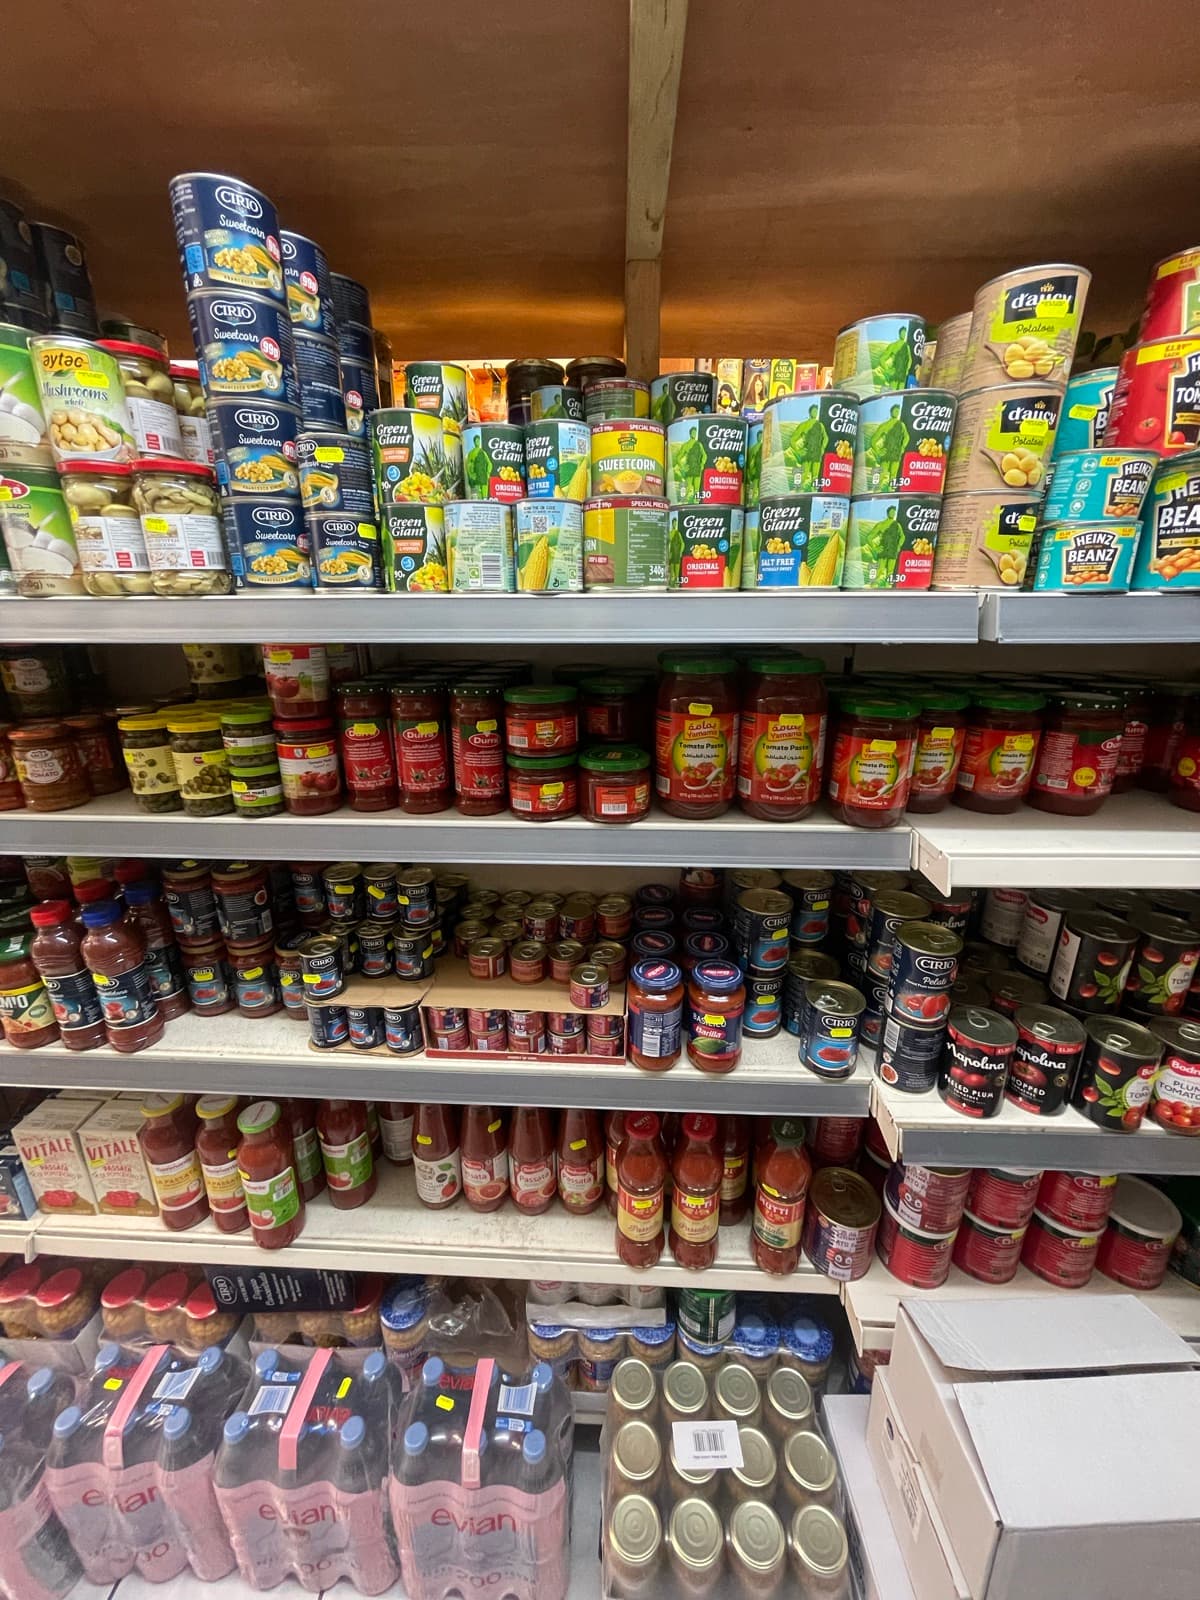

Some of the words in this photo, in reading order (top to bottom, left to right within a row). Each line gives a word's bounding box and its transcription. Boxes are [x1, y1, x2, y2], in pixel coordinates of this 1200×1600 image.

[220, 190, 261, 213] CIRIO
[219, 214, 266, 239] Sweetcorn
[301, 276, 318, 292] 99p
[213, 304, 252, 320] CIRIO
[213, 327, 259, 343] Sweetcorn
[1016, 324, 1055, 334] Potatoes
[262, 342, 279, 357] 99p
[42, 351, 84, 369] aytac
[412, 375, 440, 386] Green
[675, 380, 708, 393] Green
[43, 382, 109, 401] Mushrooms
[414, 383, 441, 393] Giant
[677, 391, 709, 403] Giant
[910, 402, 952, 419] Green
[239, 412, 275, 426] CIRIO
[912, 416, 951, 432] Giant
[377, 424, 408, 437] Green
[706, 424, 743, 439] Green
[238, 434, 282, 447] Sweetcorn
[379, 434, 412, 445] Giant
[488, 437, 523, 451] Green
[708, 436, 743, 452] Giant
[1012, 436, 1044, 447] Potatoes
[491, 449, 523, 463] Giant
[598, 459, 656, 471] SWEETCORN
[909, 461, 942, 471] ORIGINAL
[1124, 462, 1152, 475] HEINZ
[709, 476, 739, 485] ORIGINAL
[1113, 480, 1148, 493] BEANZ
[494, 483, 522, 493] ORIGINAL
[256, 510, 290, 521] CIRIO
[761, 505, 801, 521] Green
[1159, 504, 1200, 528] BEA
[324, 522, 354, 532] CIRIO
[389, 517, 422, 528] Green
[683, 515, 724, 528] Green
[762, 518, 804, 532] Giant
[255, 530, 296, 541] Sweetcorn
[391, 526, 424, 537] Giant
[685, 525, 726, 539] Giant
[325, 538, 357, 547] Sweetcorn
[1076, 532, 1114, 547] HEINZ
[775, 558, 795, 566] FREE
[1068, 549, 1115, 563] BEANZ
[649, 565, 665, 579] 340g
[687, 730, 718, 739] Yamama
[769, 731, 802, 739] Yamama
[679, 742, 705, 750] Tomato
[762, 743, 788, 751] Tomato
[855, 760, 878, 768] Tomato
[311, 958, 333, 967] CIRIO
[921, 957, 955, 970] CIRIO
[923, 976, 947, 986] Pelati
[823, 1016, 856, 1028] CIRIO
[695, 1025, 722, 1039] Barilla
[946, 1042, 1005, 1070] Napolina
[1016, 1046, 1066, 1069] apolina
[972, 1089, 994, 1099] PLUM
[21, 1138, 75, 1161] VITALE
[85, 1138, 140, 1161] VITALE
[520, 1171, 549, 1183] Passata
[562, 1172, 592, 1184] Passata
[216, 1278, 233, 1302] CIRIO
[439, 1375, 475, 1390] evia
[431, 1507, 517, 1537] evian
